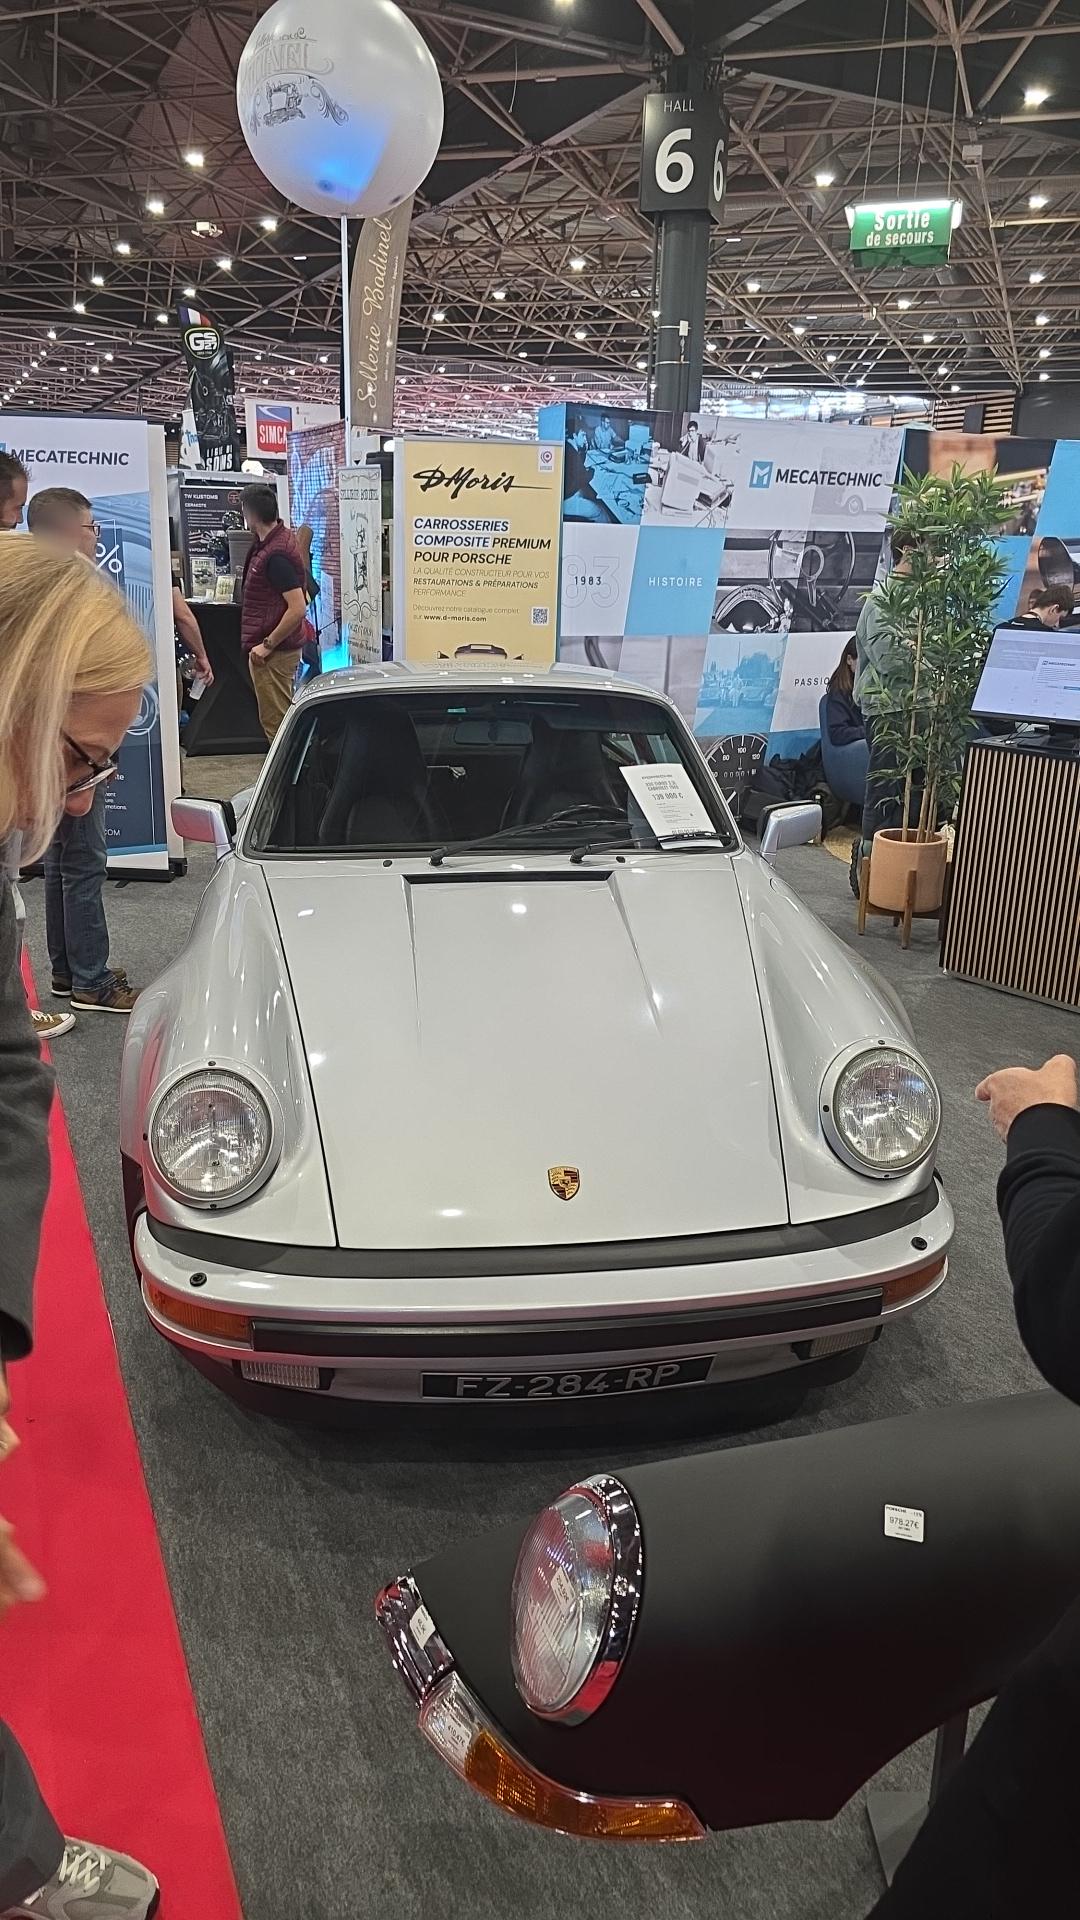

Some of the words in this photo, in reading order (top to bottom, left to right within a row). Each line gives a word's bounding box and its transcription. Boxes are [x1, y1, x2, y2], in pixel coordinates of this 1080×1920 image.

[663, 99, 695, 112] HALL
[655, 127, 695, 194] 6
[713, 138, 725, 202] 6
[873, 211, 931, 231] Sortie
[866, 231, 881, 247] de
[884, 230, 934, 246] secours
[259, 424, 287, 444] SIMCA
[11, 448, 129, 466] MECATECHNIC
[775, 469, 883, 488] MECATECHNIC
[414, 518, 509, 532] CARROSSERIES
[414, 534, 490, 548] COMPOSITE
[492, 538, 551, 549] PREMIUM
[414, 551, 449, 563] POUR
[452, 552, 512, 565] PORSCHE
[413, 567, 422, 575] LA
[455, 568, 511, 578] CONSTRUCTEUR
[413, 577, 474, 587] RESTAURATIONS
[483, 579, 539, 589] PRÉPARATIONS
[574, 576, 602, 586] 1983
[648, 577, 703, 587] HISTOIRE
[413, 588, 466, 597] PERFORMANCE
[794, 677, 830, 687] PASSIO
[455, 1363, 681, 1398] FZ-284-RP
